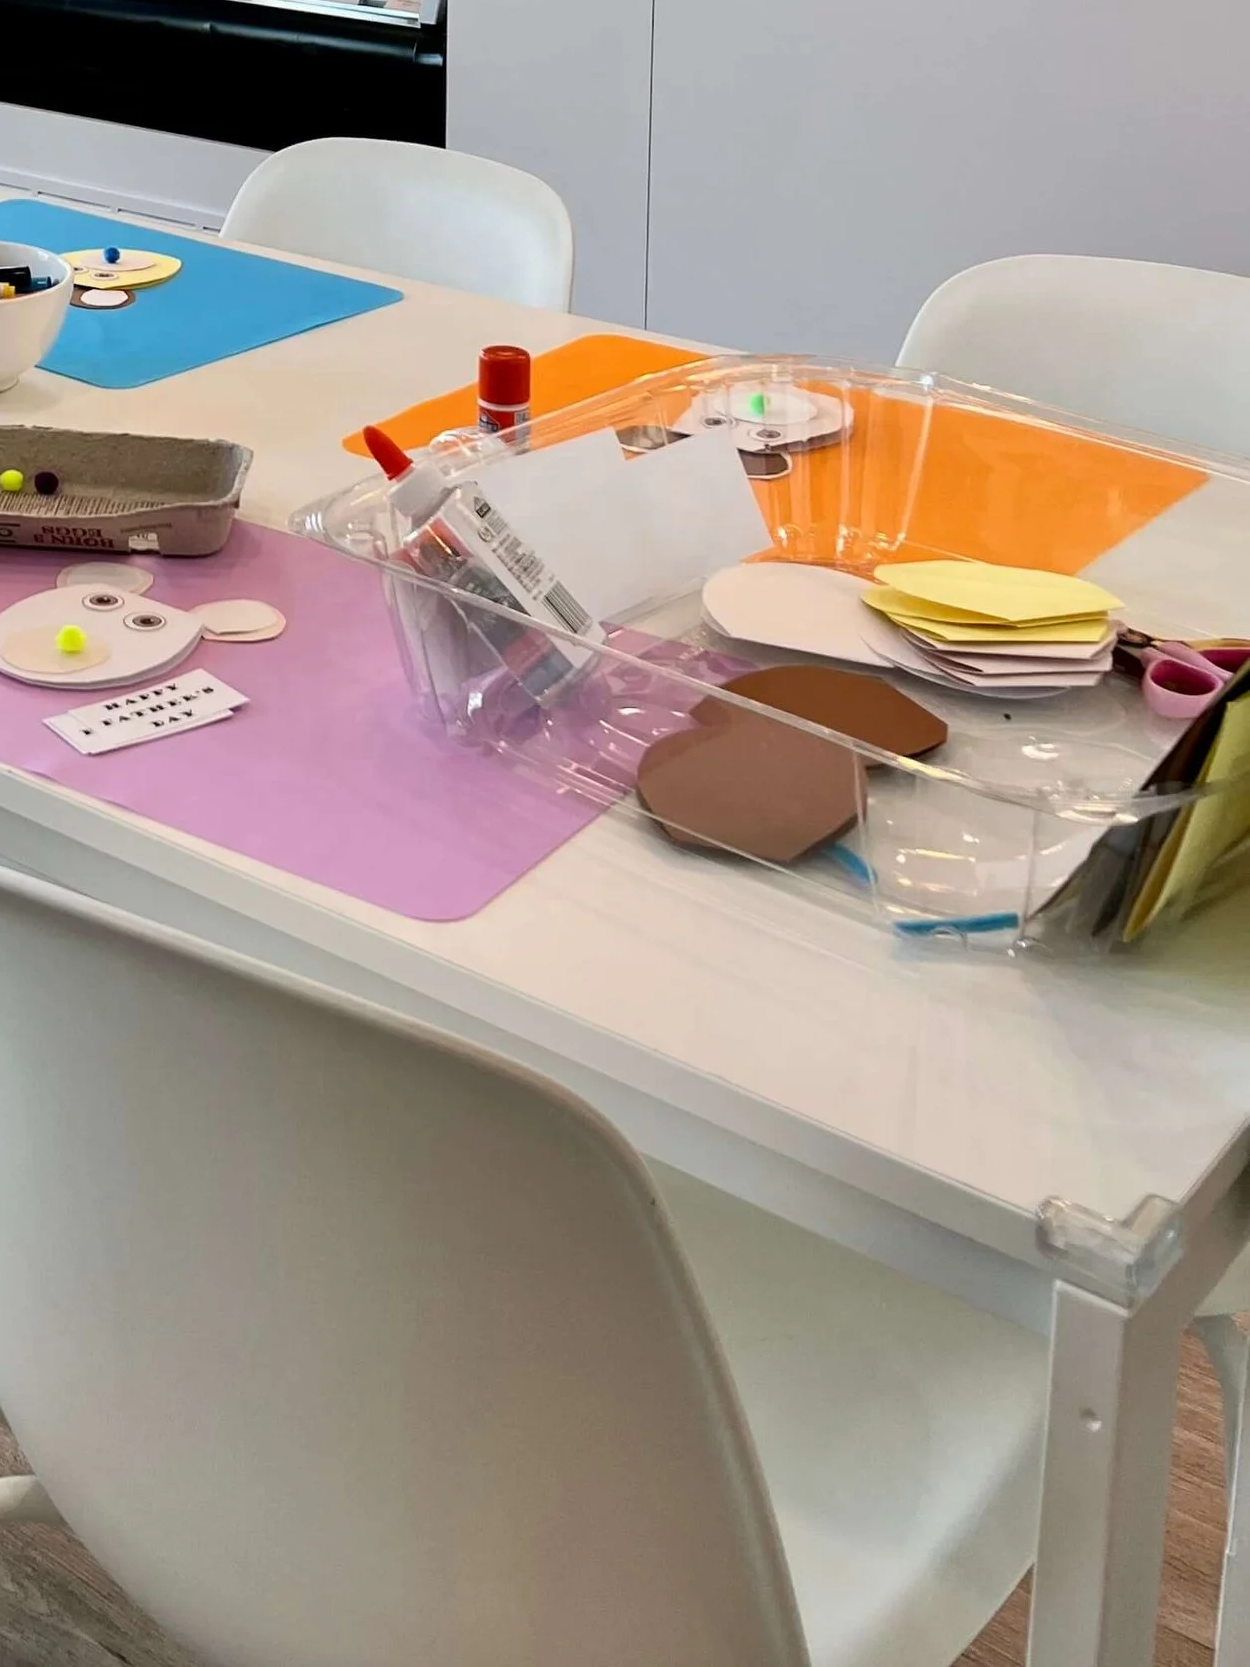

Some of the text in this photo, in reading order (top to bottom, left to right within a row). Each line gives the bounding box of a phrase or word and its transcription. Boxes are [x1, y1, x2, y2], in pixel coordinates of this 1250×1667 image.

[101, 685, 216, 727] FATHER'S
[103, 682, 178, 712] HAPPY
[150, 708, 195, 728] DAY
